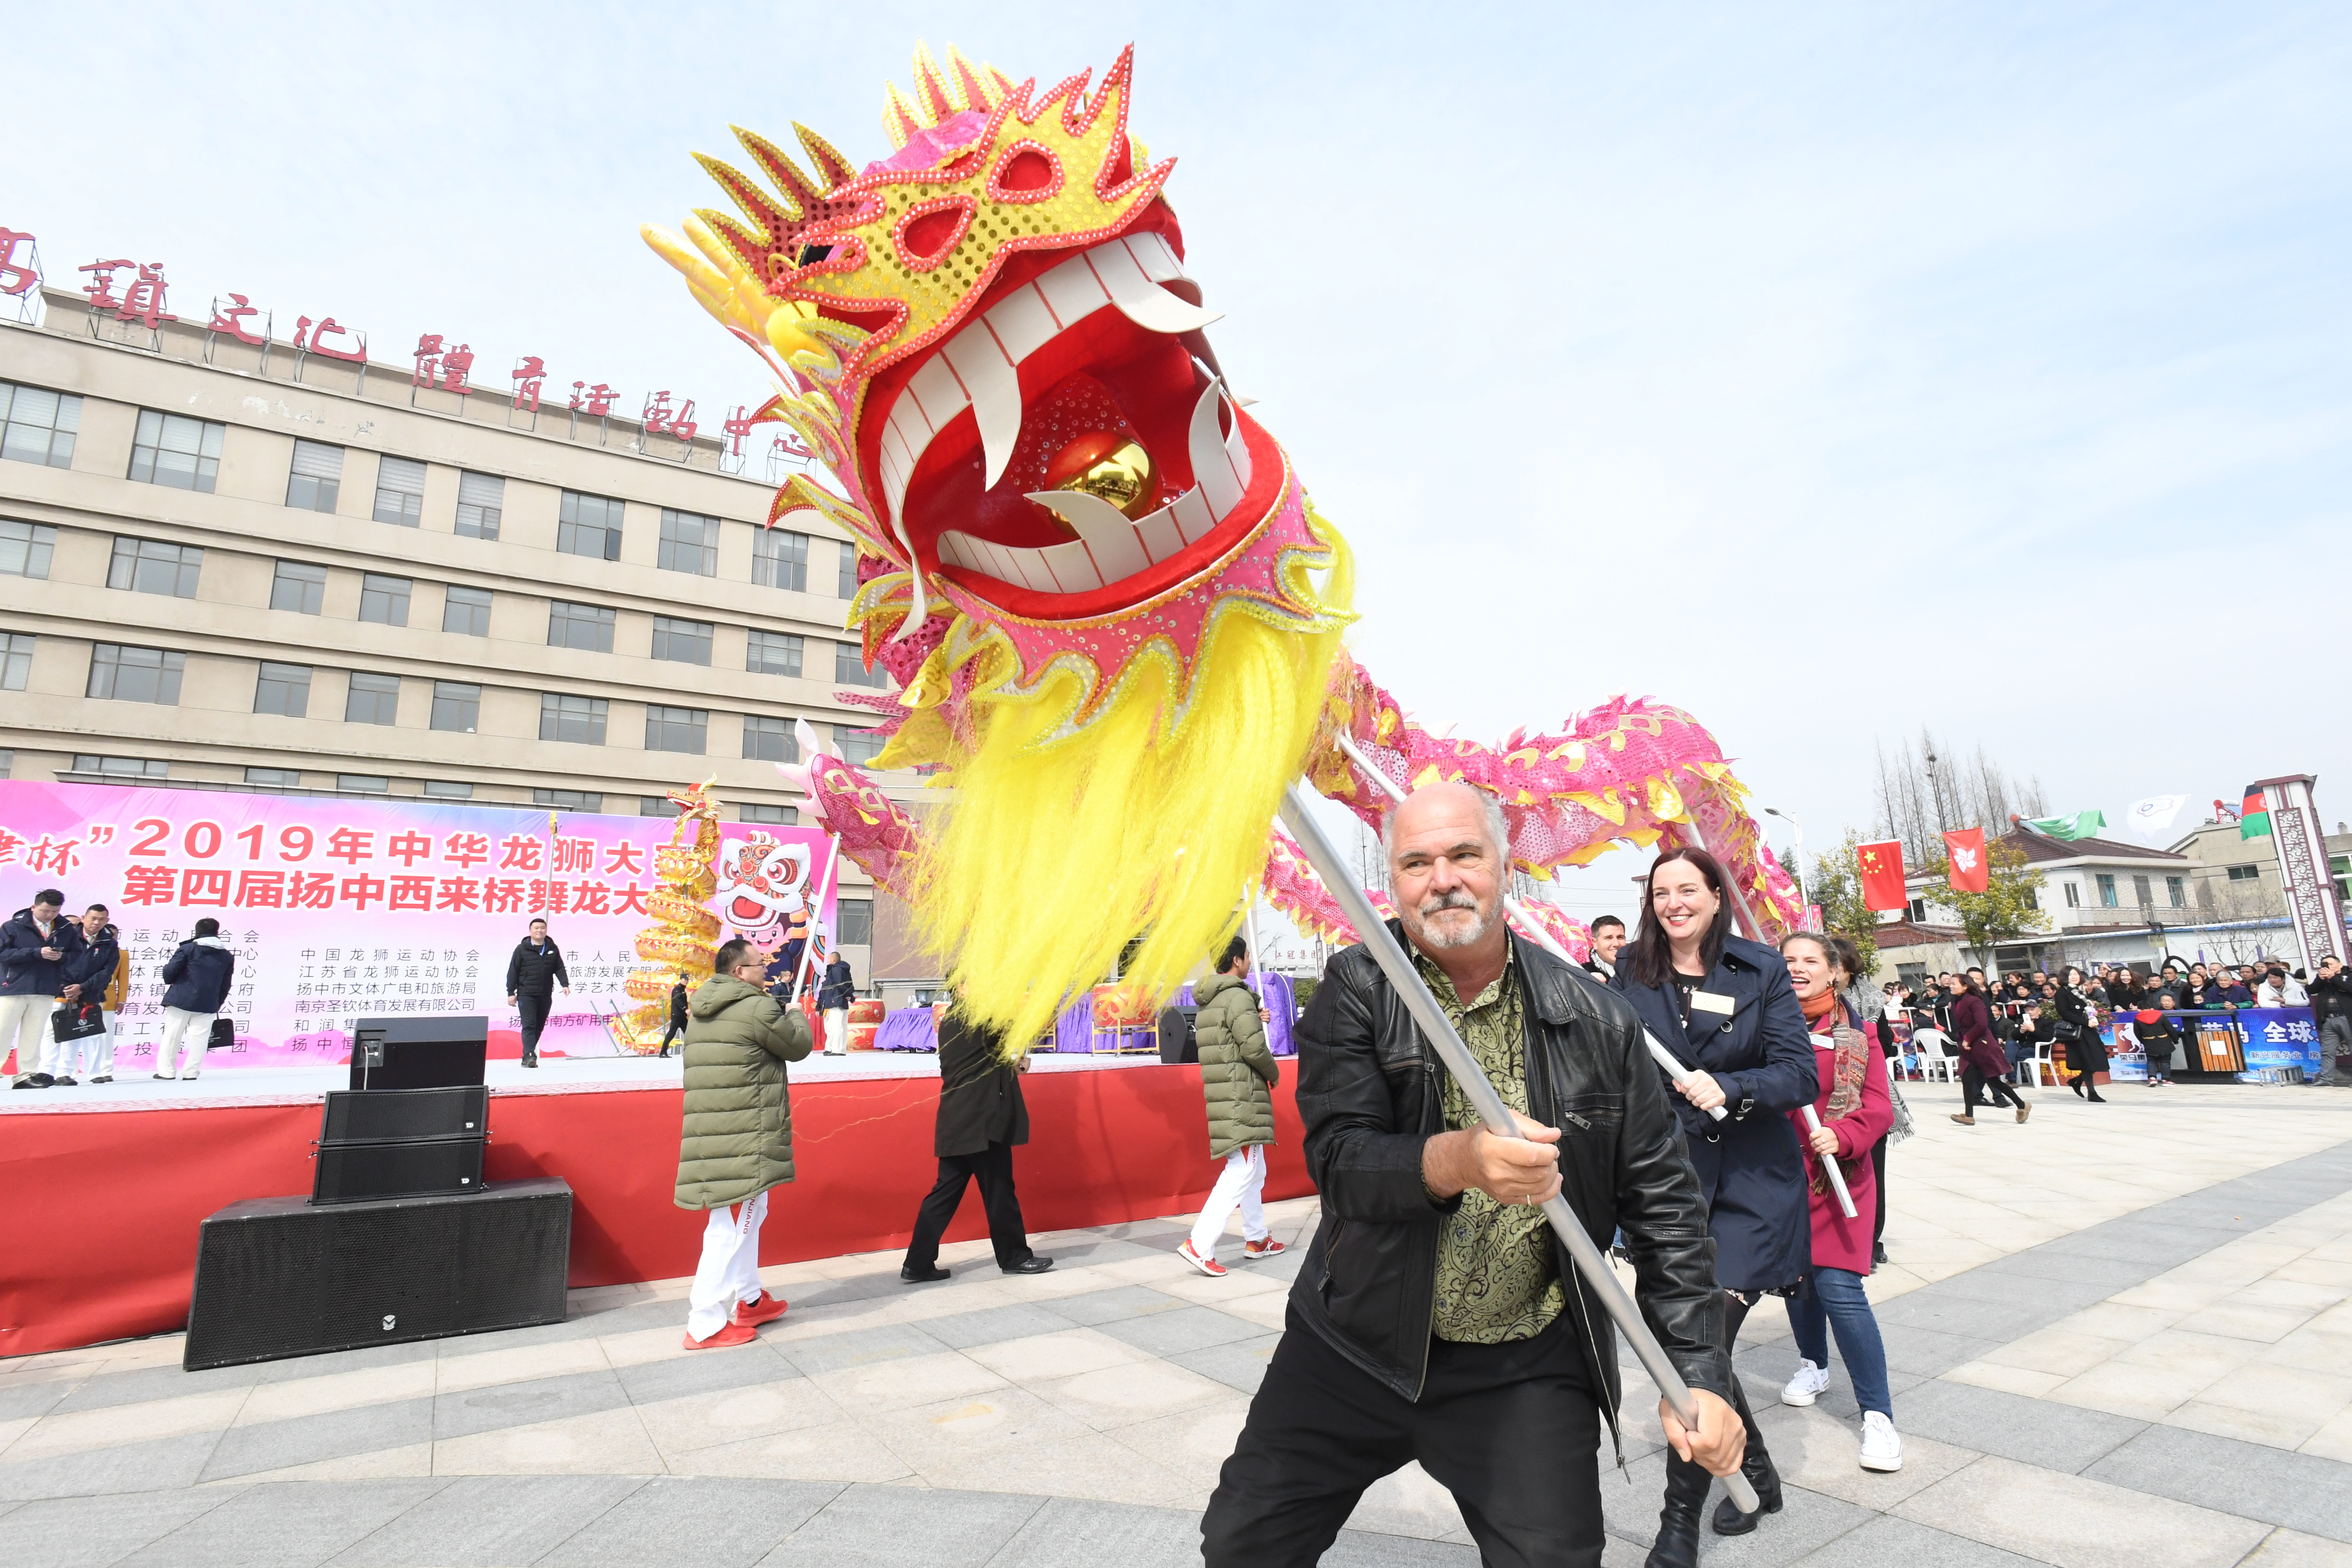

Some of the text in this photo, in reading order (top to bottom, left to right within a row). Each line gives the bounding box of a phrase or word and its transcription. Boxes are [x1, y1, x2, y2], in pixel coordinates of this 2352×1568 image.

[129, 819, 686, 877] 2019年中华龙狮大
[122, 866, 677, 916] 第四届扬中西来桥舞龙大
[301, 948, 479, 961] 中国龙狮运动协会
[299, 965, 479, 978] 江苏省龙狮运动协会
[297, 982, 476, 996] 扬中市文体广电和旅游局
[295, 999, 475, 1013] 南京圣钦体育发展有限公司
[2263, 1021, 2319, 1043] 全球
[743, 1196, 756, 1234] NJIANG
